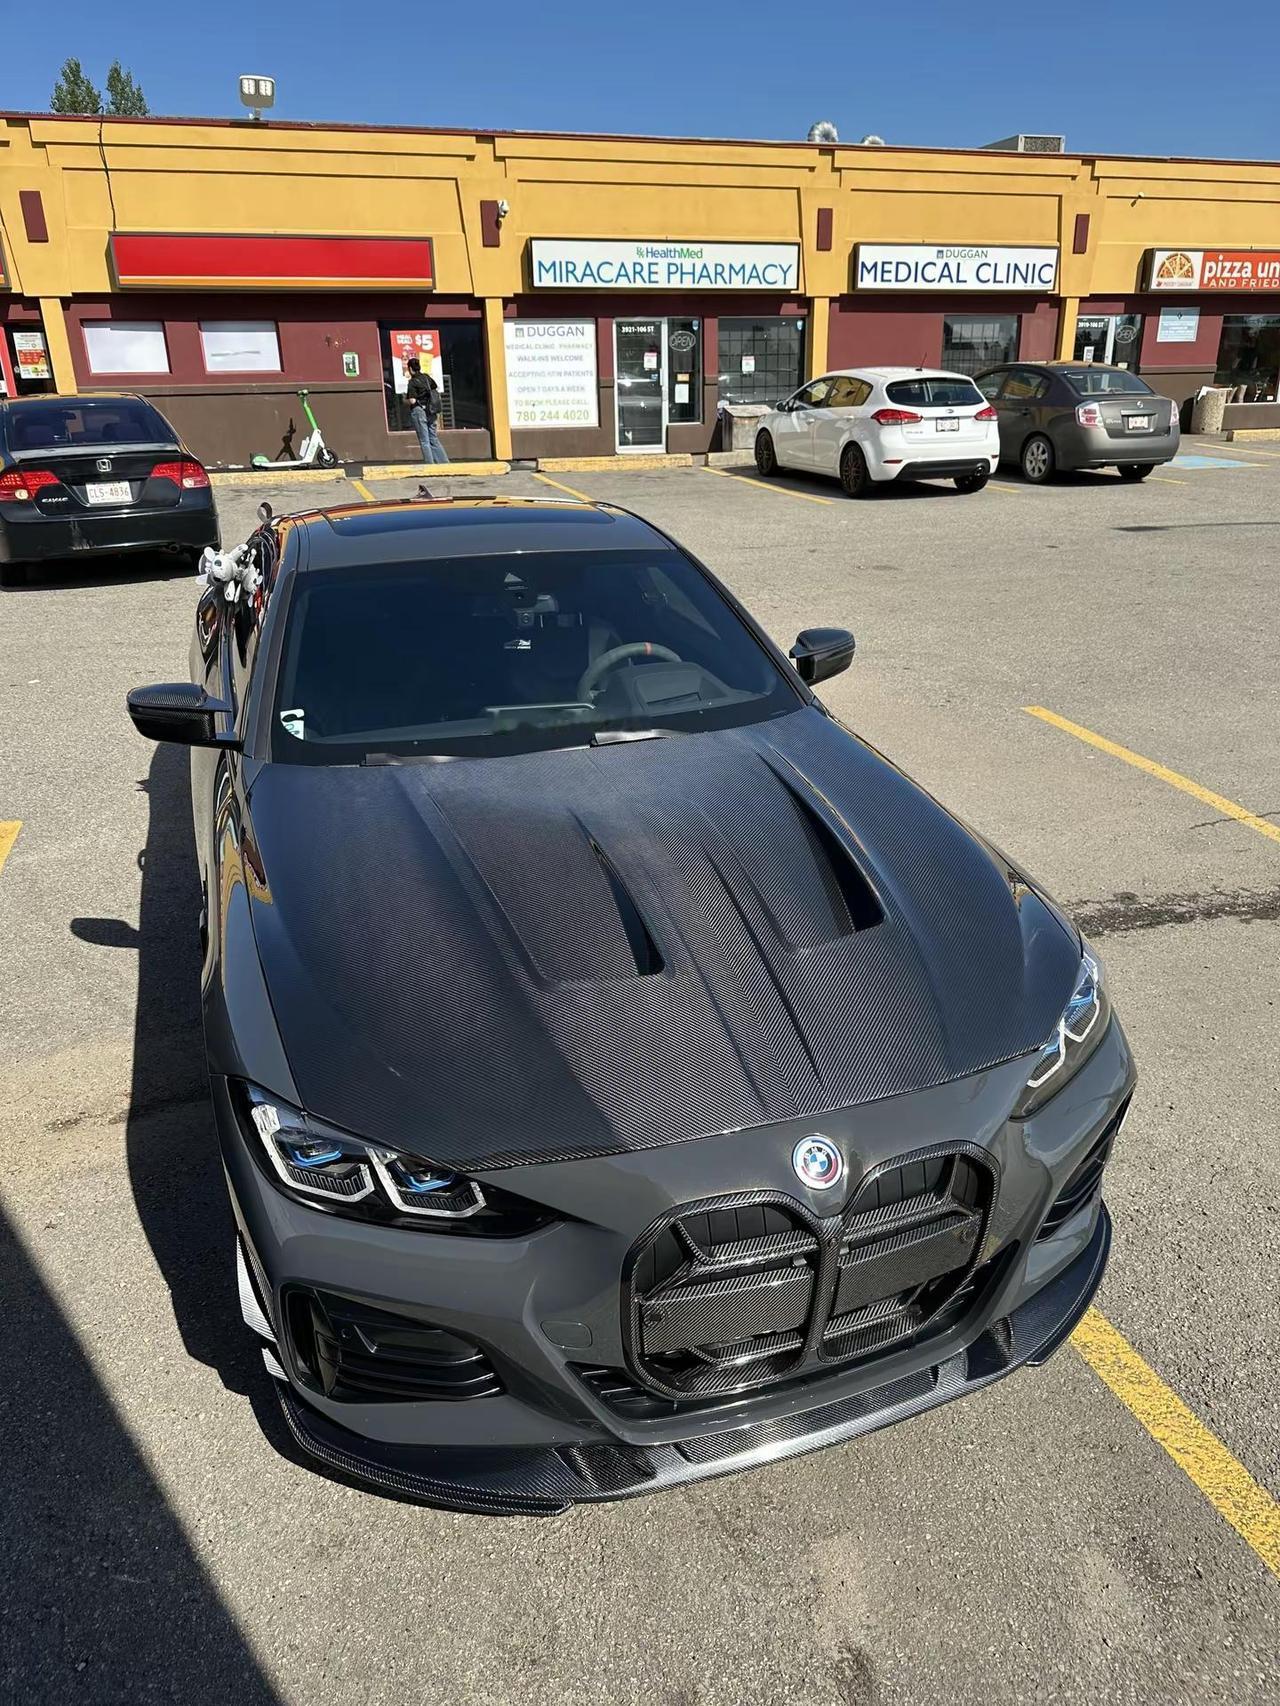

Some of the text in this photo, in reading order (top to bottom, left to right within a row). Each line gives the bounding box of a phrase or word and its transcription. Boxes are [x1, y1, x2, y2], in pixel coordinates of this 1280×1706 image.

[646, 246, 703, 259] HealthMed
[945, 249, 988, 259] DUGGAN
[538, 260, 793, 285] MIRACARE PHARMACY
[860, 261, 1054, 284] MEDICAL CLINIC
[1204, 254, 1252, 284] pizza
[1209, 278, 1280, 288] AND FRIED
[527, 326, 585, 337] DUGGAN
[414, 334, 434, 351] $5
[671, 335, 694, 347] OPEN
[551, 354, 584, 362] WELCOME
[516, 409, 590, 422] 780 244 4020
